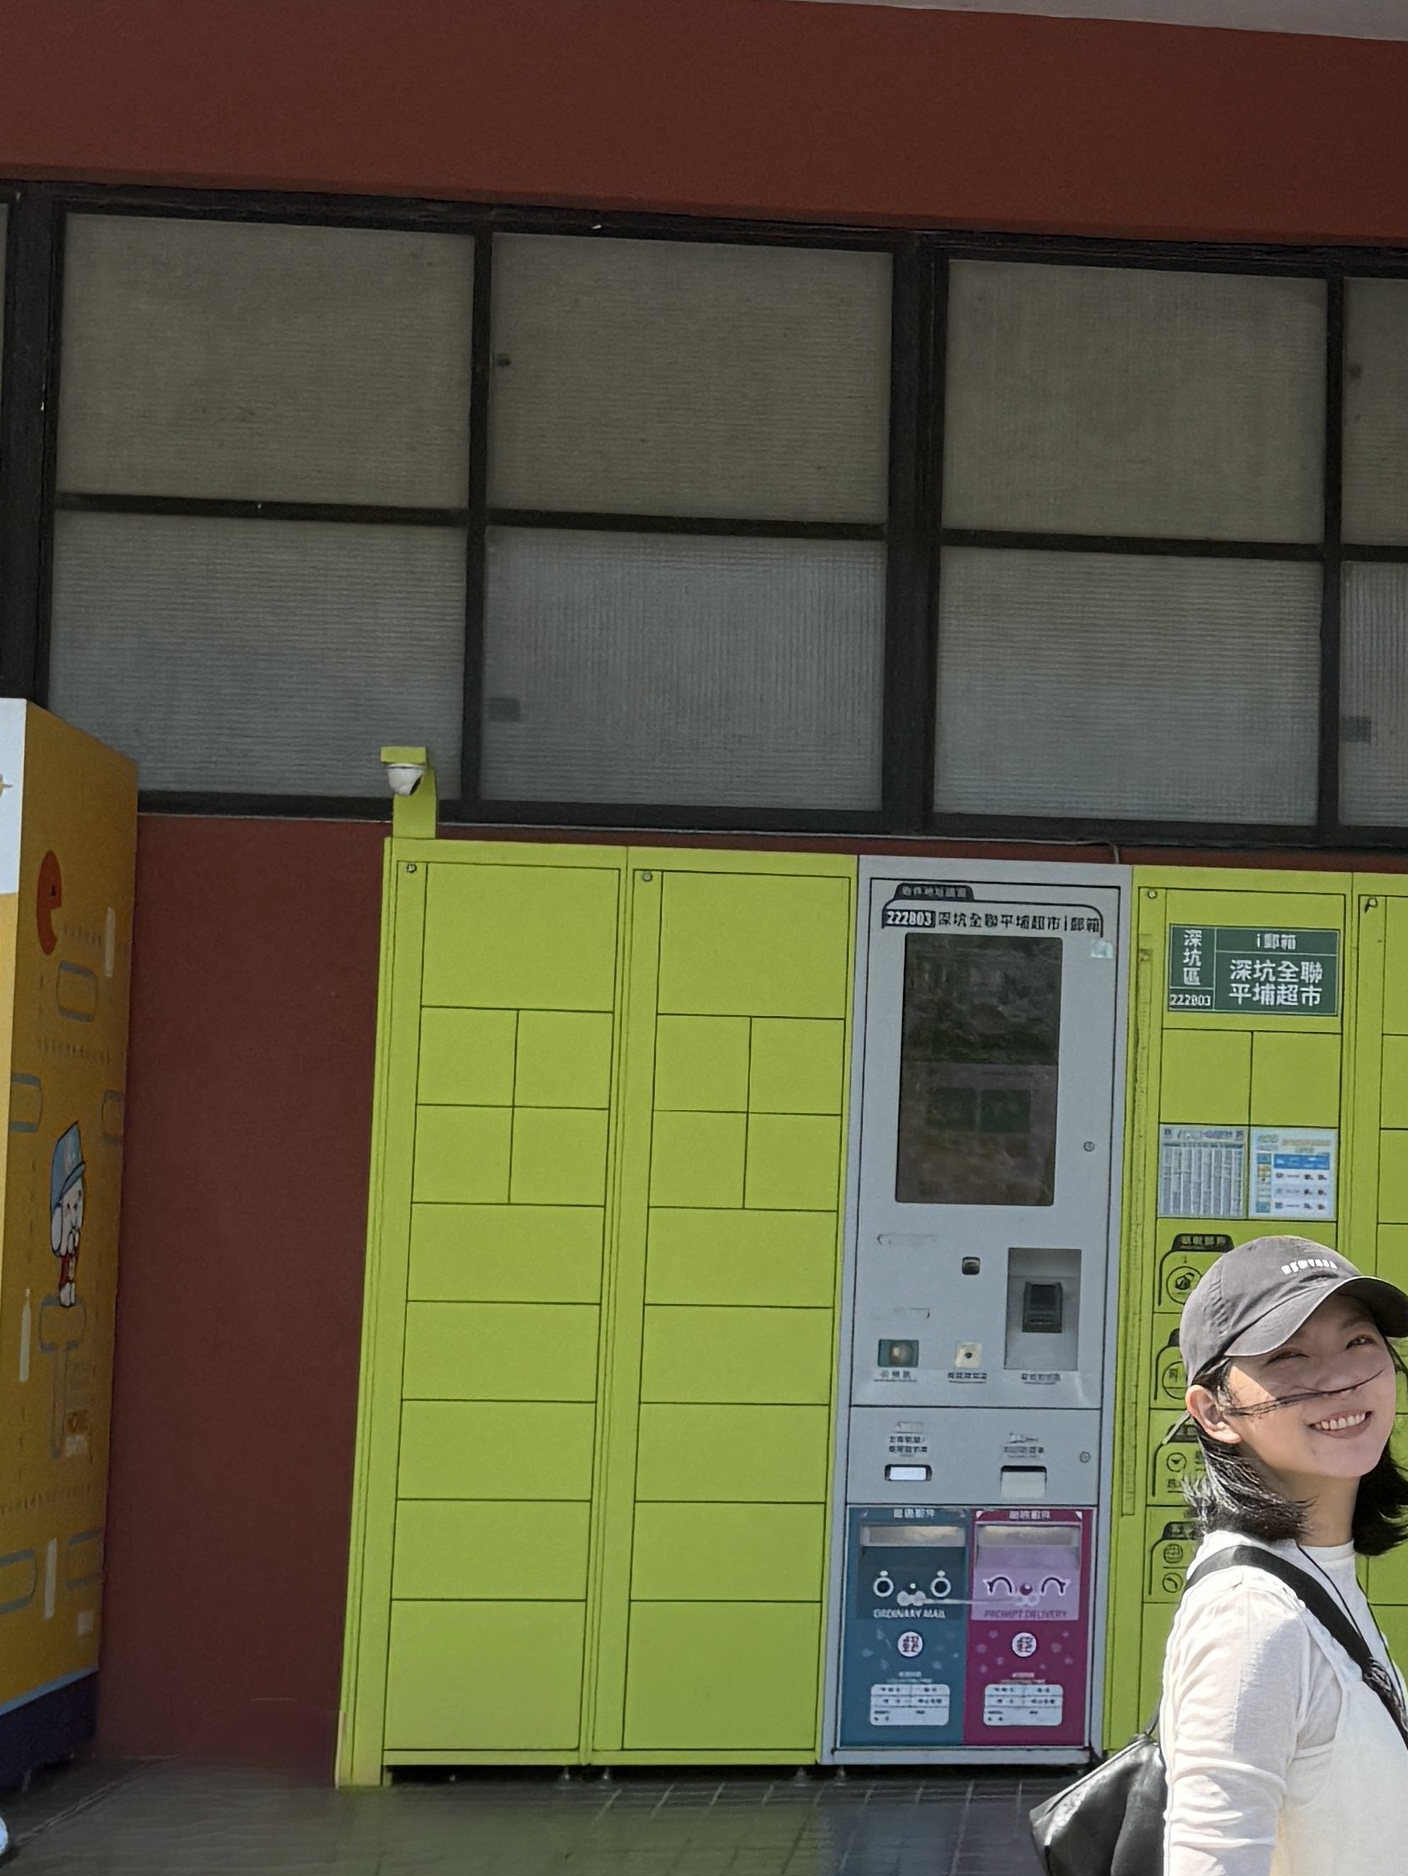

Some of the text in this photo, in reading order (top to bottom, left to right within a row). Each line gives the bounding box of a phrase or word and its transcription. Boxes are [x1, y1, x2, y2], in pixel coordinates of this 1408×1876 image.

[886, 911, 933, 927] 222803
[1183, 929, 1202, 986] 深坑區
[1229, 959, 1323, 983] 深坑全聯
[1229, 982, 1323, 1007] 平埔超市
